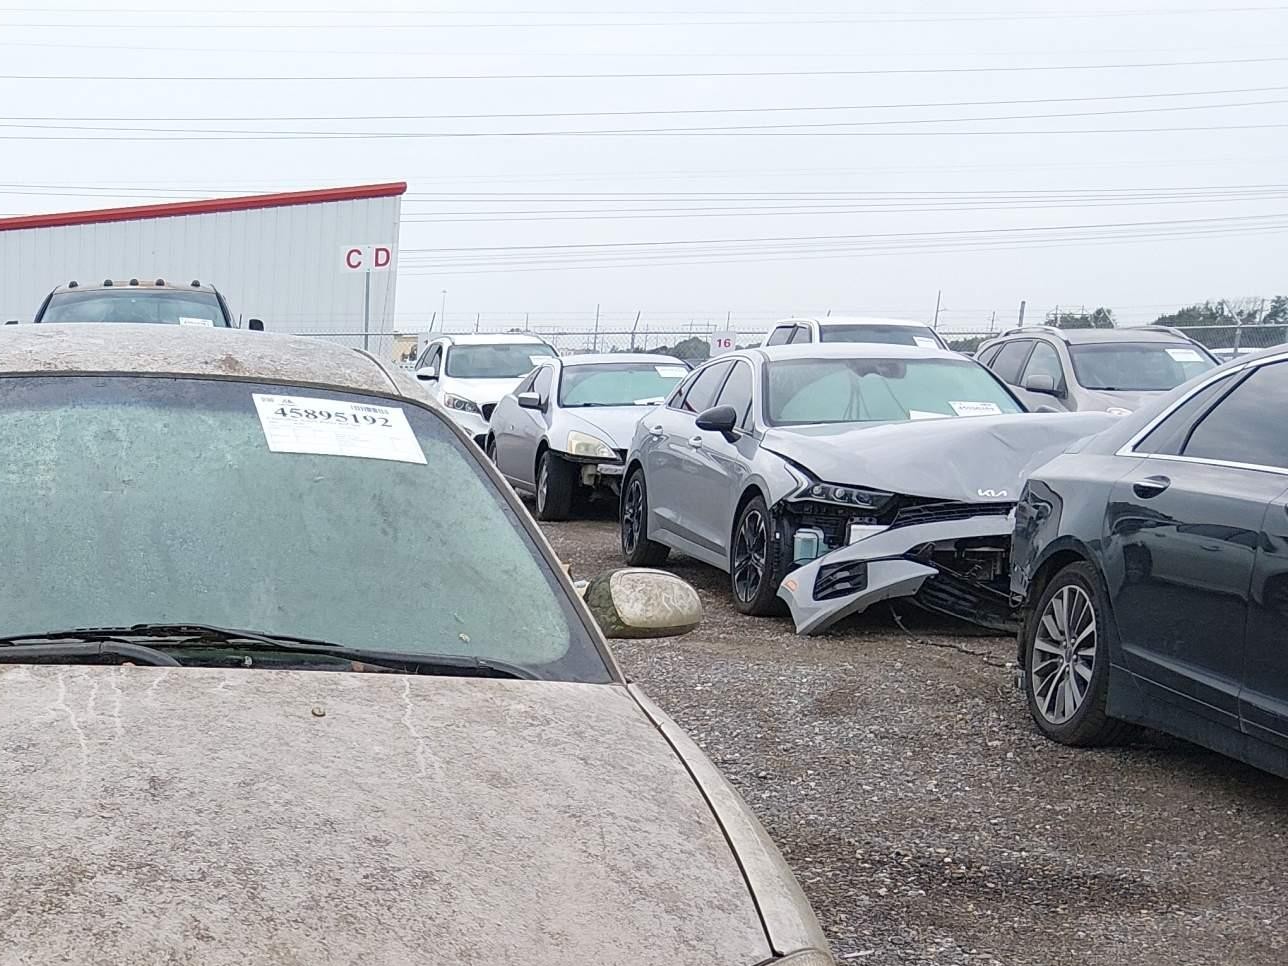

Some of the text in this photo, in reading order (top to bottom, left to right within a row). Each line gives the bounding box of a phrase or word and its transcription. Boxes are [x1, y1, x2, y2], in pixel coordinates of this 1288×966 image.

[346, 249, 362, 269] C
[374, 247, 391, 267] D
[716, 338, 732, 348] 16
[273, 406, 393, 428] 45895192
